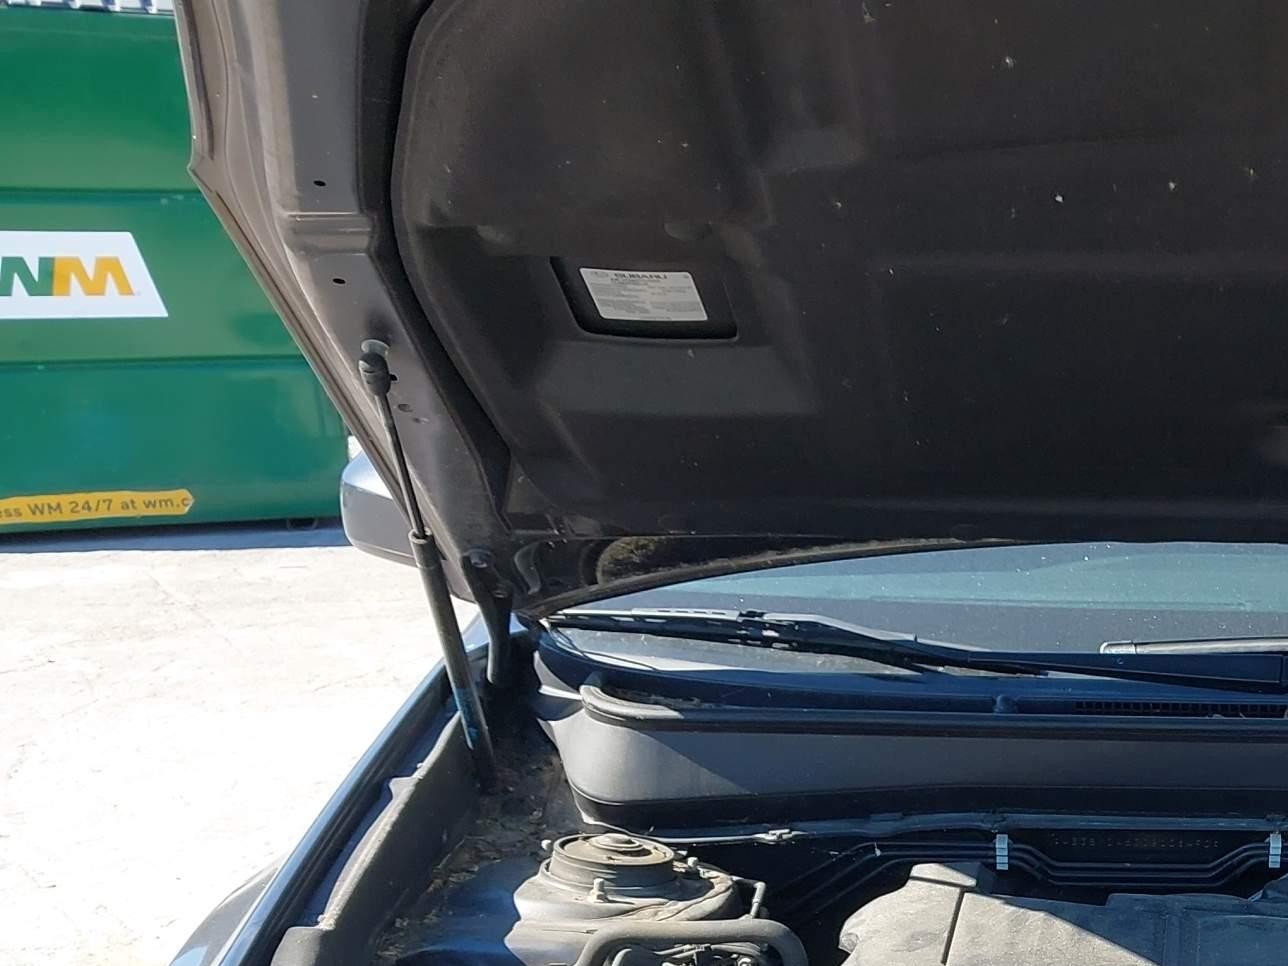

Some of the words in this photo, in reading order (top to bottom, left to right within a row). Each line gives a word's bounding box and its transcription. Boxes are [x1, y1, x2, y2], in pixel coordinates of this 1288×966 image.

[0, 508, 22, 519] ss
[28, 502, 64, 516] WM
[69, 498, 113, 514] 24/7
[120, 497, 138, 510] at
